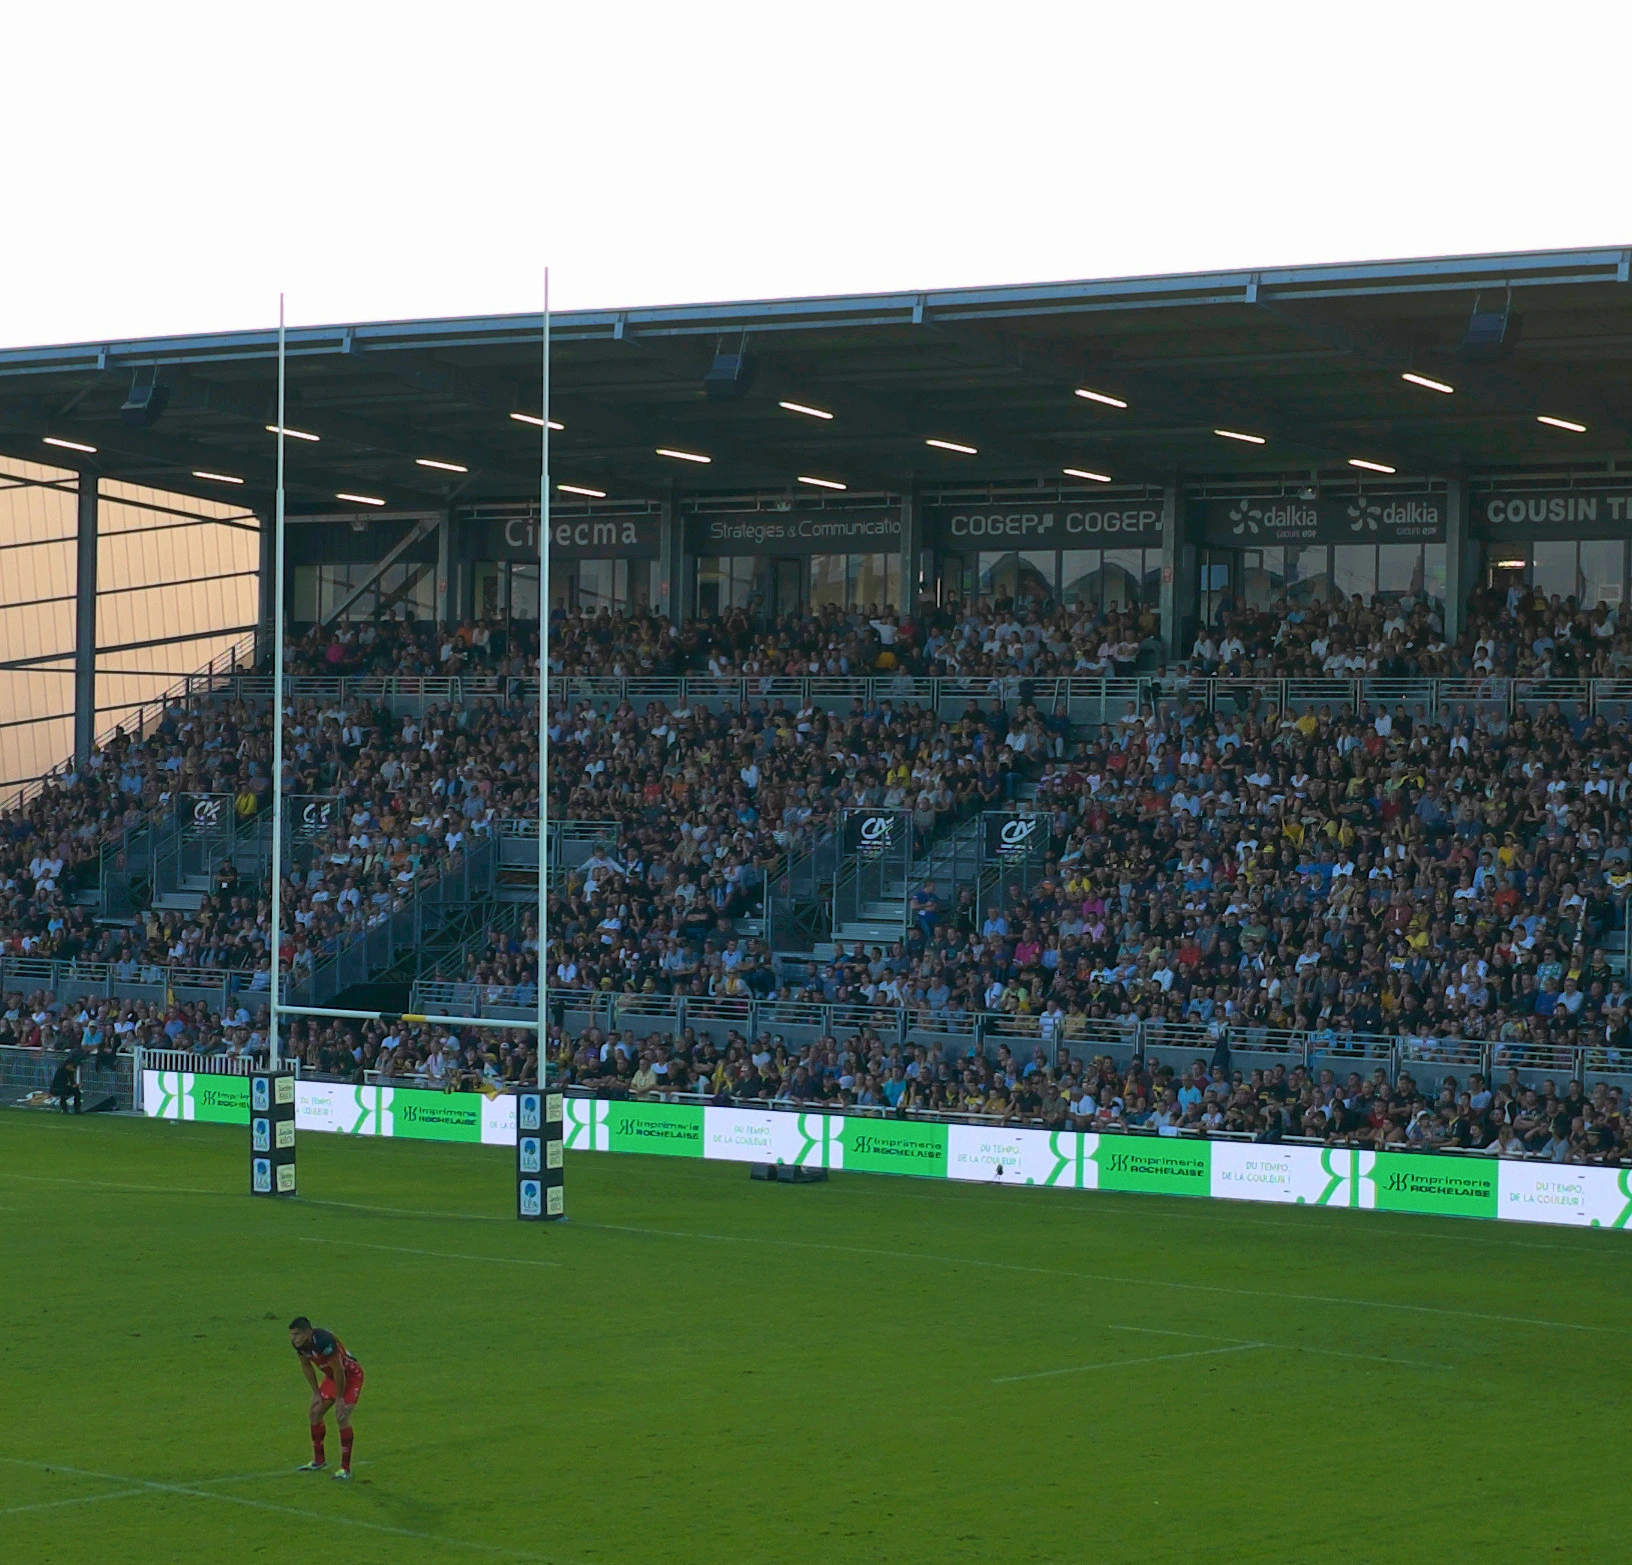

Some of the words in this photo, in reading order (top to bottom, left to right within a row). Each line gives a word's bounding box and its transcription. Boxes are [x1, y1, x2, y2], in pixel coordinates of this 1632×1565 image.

[1264, 505, 1317, 527] dalkia
[1382, 502, 1438, 524] dalkia
[1487, 497, 1597, 522] COUSIN
[505, 518, 638, 547] Ciecma
[787, 525, 797, 538] &
[1131, 1155, 1204, 1168] Imprimerie
[1130, 1165, 1204, 1177] ROCHELAISE
[1411, 1173, 1491, 1187] Imprimerie
[1410, 1184, 1491, 1198] ROCHELAISE
